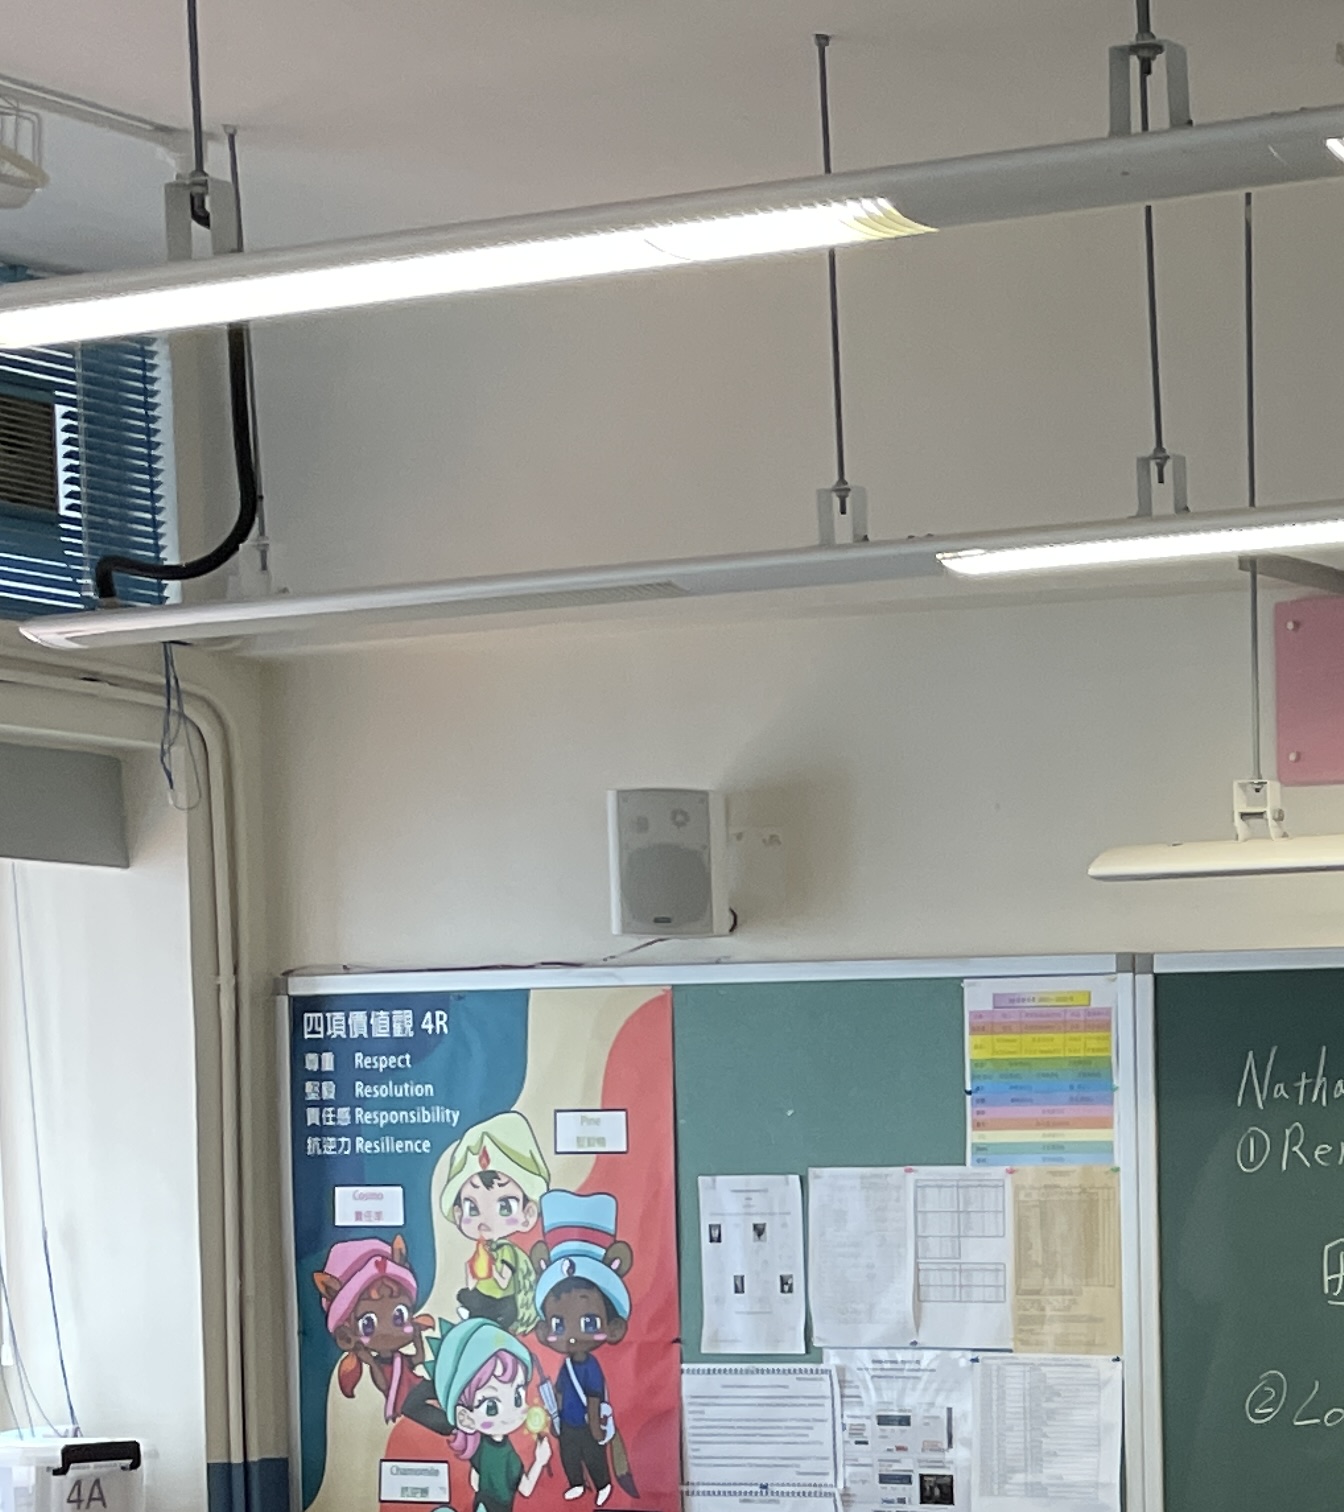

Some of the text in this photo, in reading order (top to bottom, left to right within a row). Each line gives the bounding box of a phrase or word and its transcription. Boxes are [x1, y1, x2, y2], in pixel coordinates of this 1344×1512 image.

[303, 1010, 449, 1039] 四項價值觀 4R
[354, 1052, 412, 1072] Respect
[354, 1080, 434, 1098] Resolution
[354, 1105, 460, 1128] Responsibility
[355, 1135, 431, 1154] Resilience
[66, 1478, 107, 1510] 4A
